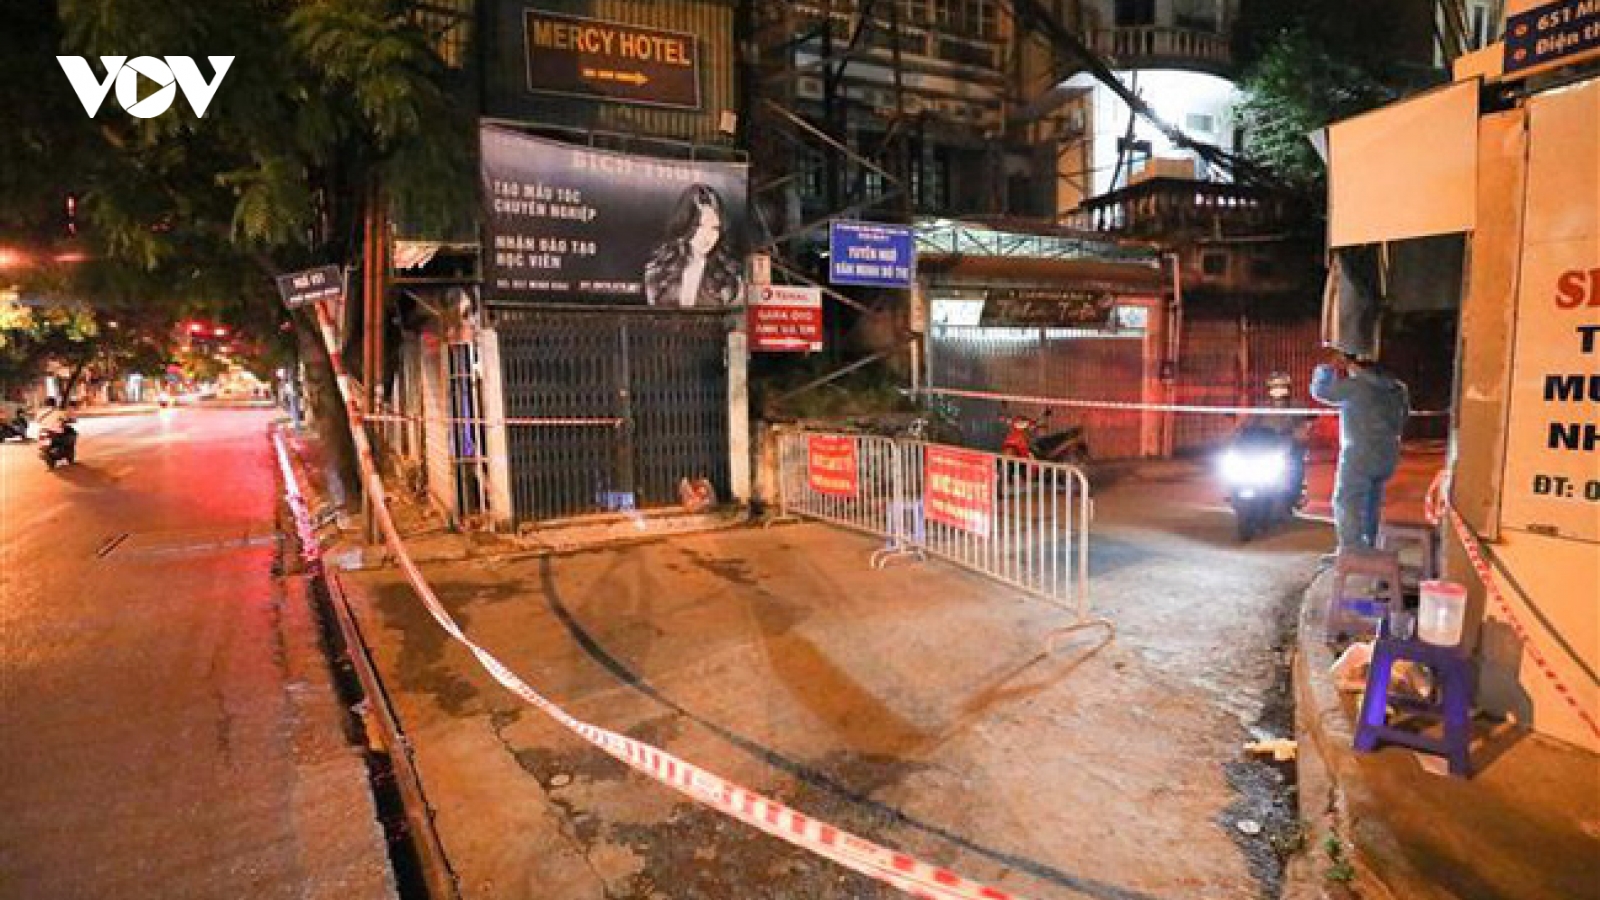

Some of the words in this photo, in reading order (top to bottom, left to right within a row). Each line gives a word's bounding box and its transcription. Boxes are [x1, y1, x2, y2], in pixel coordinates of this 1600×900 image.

[1538, 8, 1570, 30] 651
[533, 21, 614, 53] MERCY
[619, 34, 691, 65] HOTEL
[1533, 474, 1574, 498] ĐT:
